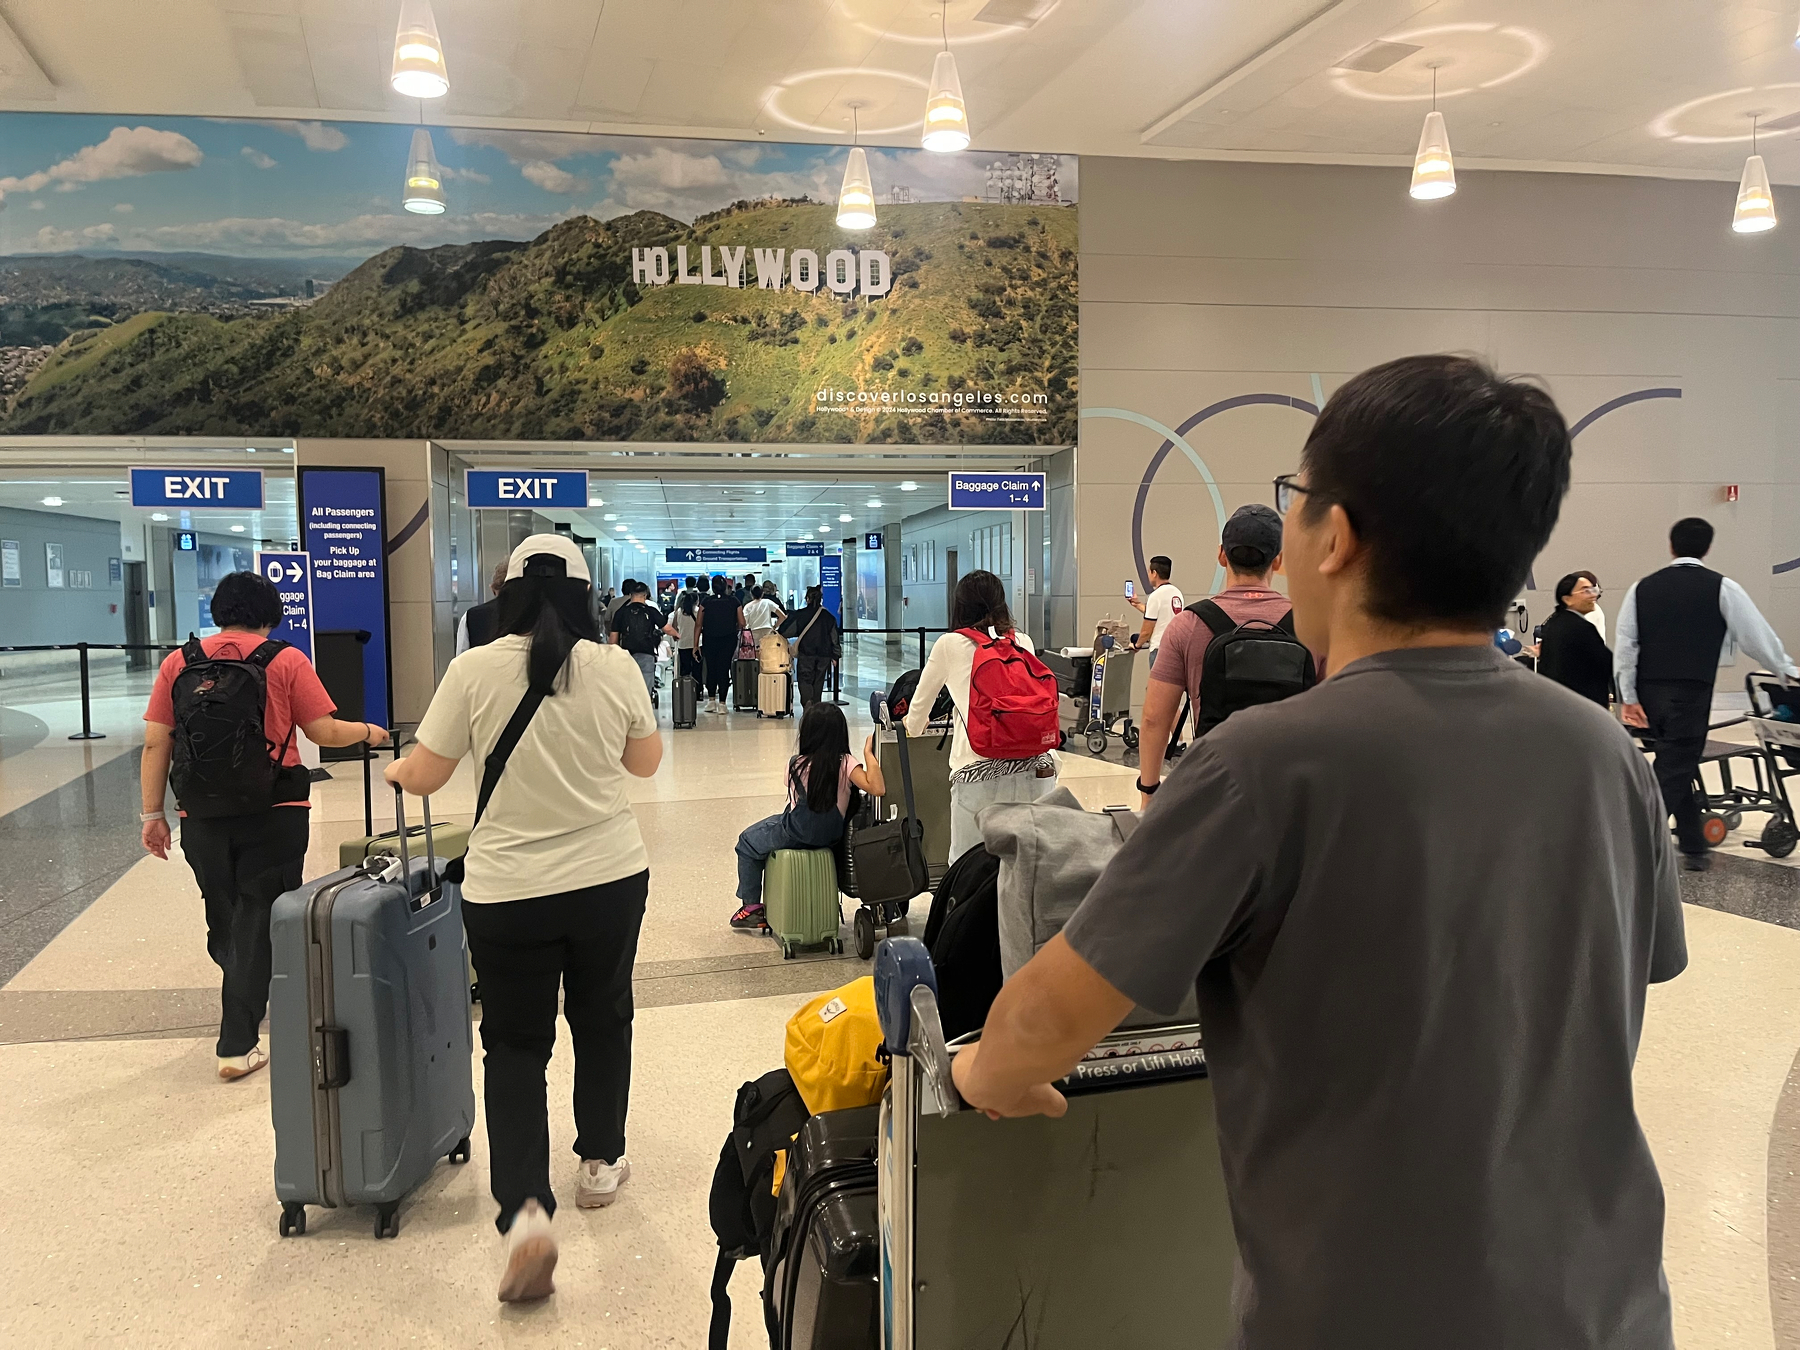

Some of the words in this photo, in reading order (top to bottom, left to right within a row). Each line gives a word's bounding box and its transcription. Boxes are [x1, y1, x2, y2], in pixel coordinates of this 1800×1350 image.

[632, 245, 891, 296] HOLLYWOOD
[816, 388, 1048, 407] discoverlosangeles.com
[855, 406, 875, 414] Design
[164, 476, 230, 499] EXIT
[498, 477, 558, 499] EXIT
[955, 480, 999, 492] Baggage
[1001, 480, 1029, 491] Claim
[312, 507, 324, 516] All
[325, 507, 375, 518] Passengers
[309, 522, 340, 531] (including
[341, 522, 377, 531] connecting
[323, 531, 363, 540] passengers)
[330, 546, 347, 555] Pick
[348, 546, 360, 556] Up
[313, 559, 332, 568] your
[333, 558, 367, 568] baggage
[368, 558, 377, 566] at
[316, 569, 332, 580] Bag
[333, 569, 356, 578] Claim
[280, 592, 305, 603] ggage
[283, 605, 305, 615] Claim
[1076, 1065, 1119, 1079] Press
[1122, 1062, 1138, 1074] or
[1141, 1055, 1166, 1072] Lift
[1168, 1053, 1207, 1068] Han
